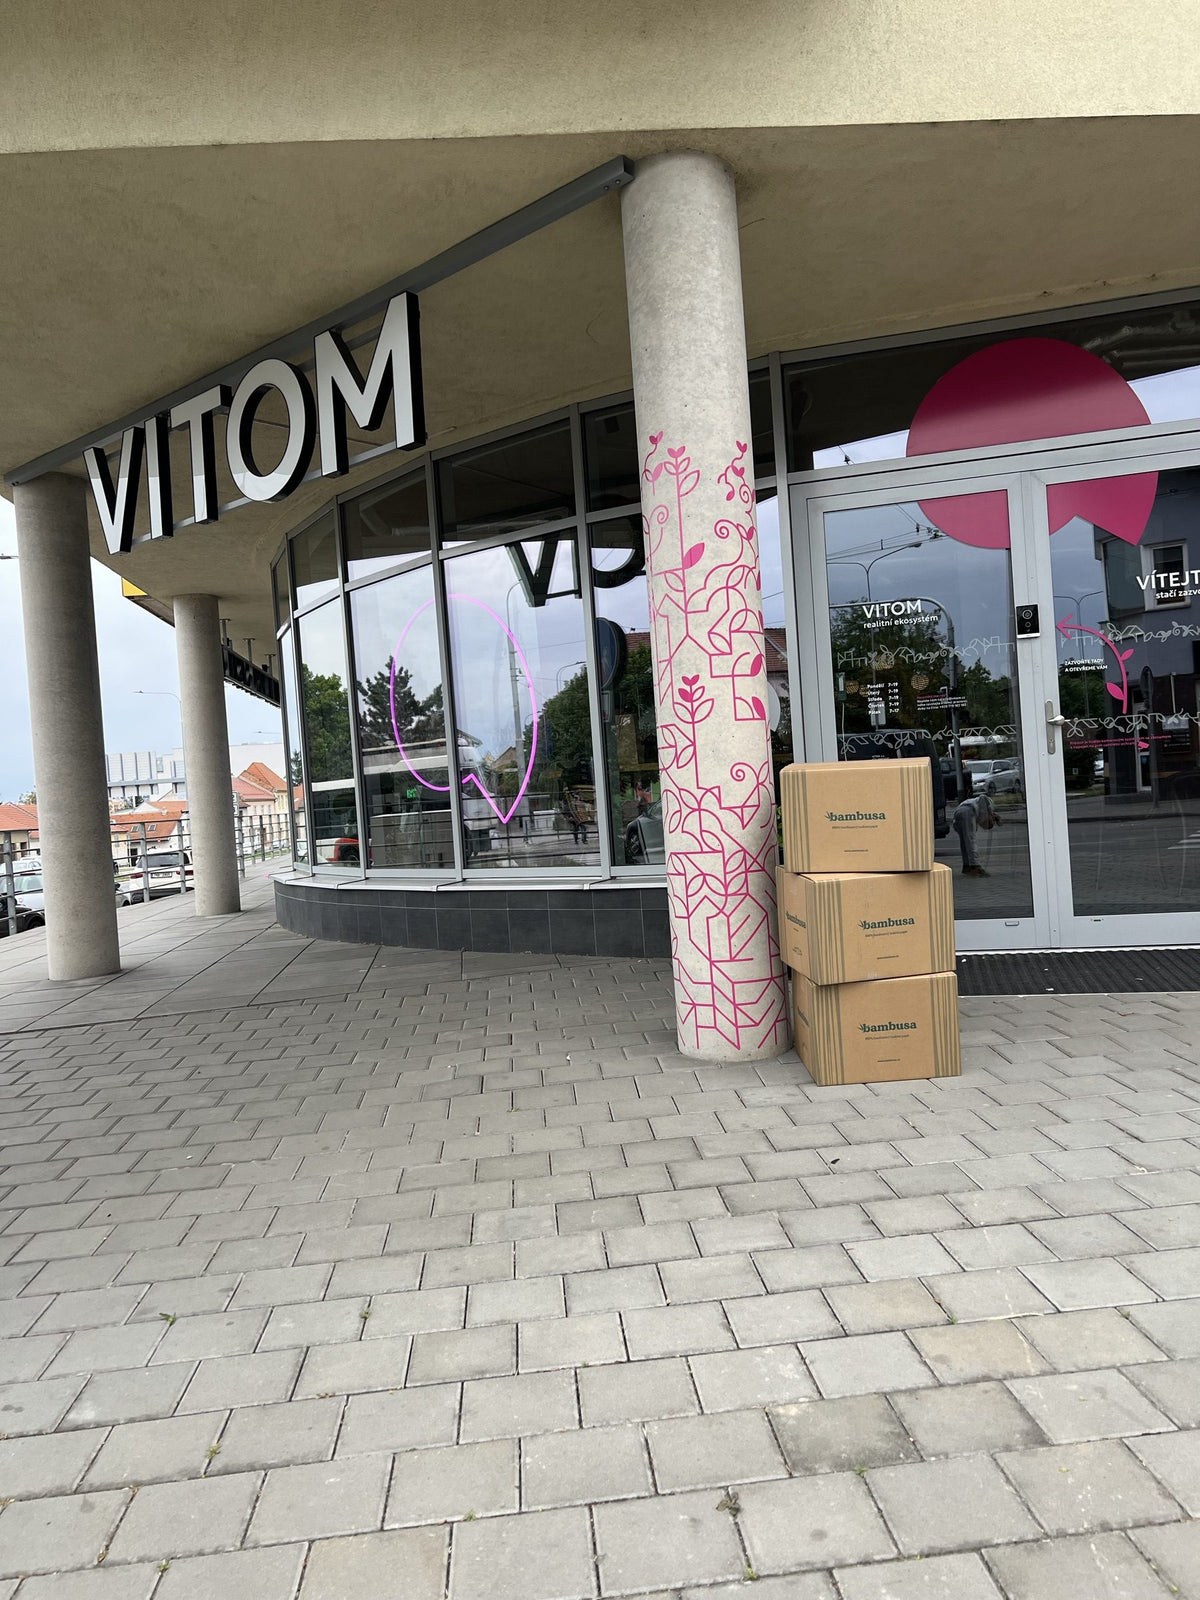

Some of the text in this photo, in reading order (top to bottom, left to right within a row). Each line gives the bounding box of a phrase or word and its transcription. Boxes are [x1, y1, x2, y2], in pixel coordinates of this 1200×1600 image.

[83, 291, 425, 555] VITOM
[1135, 569, 1200, 590] VÍTEJT
[1155, 589, 1177, 599] stačí
[862, 599, 922, 619] VITOM
[863, 614, 939, 629] realitní ekosystém
[1069, 665, 1096, 673] OTEVŘEME
[828, 811, 886, 822] bambusa
[861, 917, 915, 930] bambusa
[861, 1021, 917, 1033] bambusa
